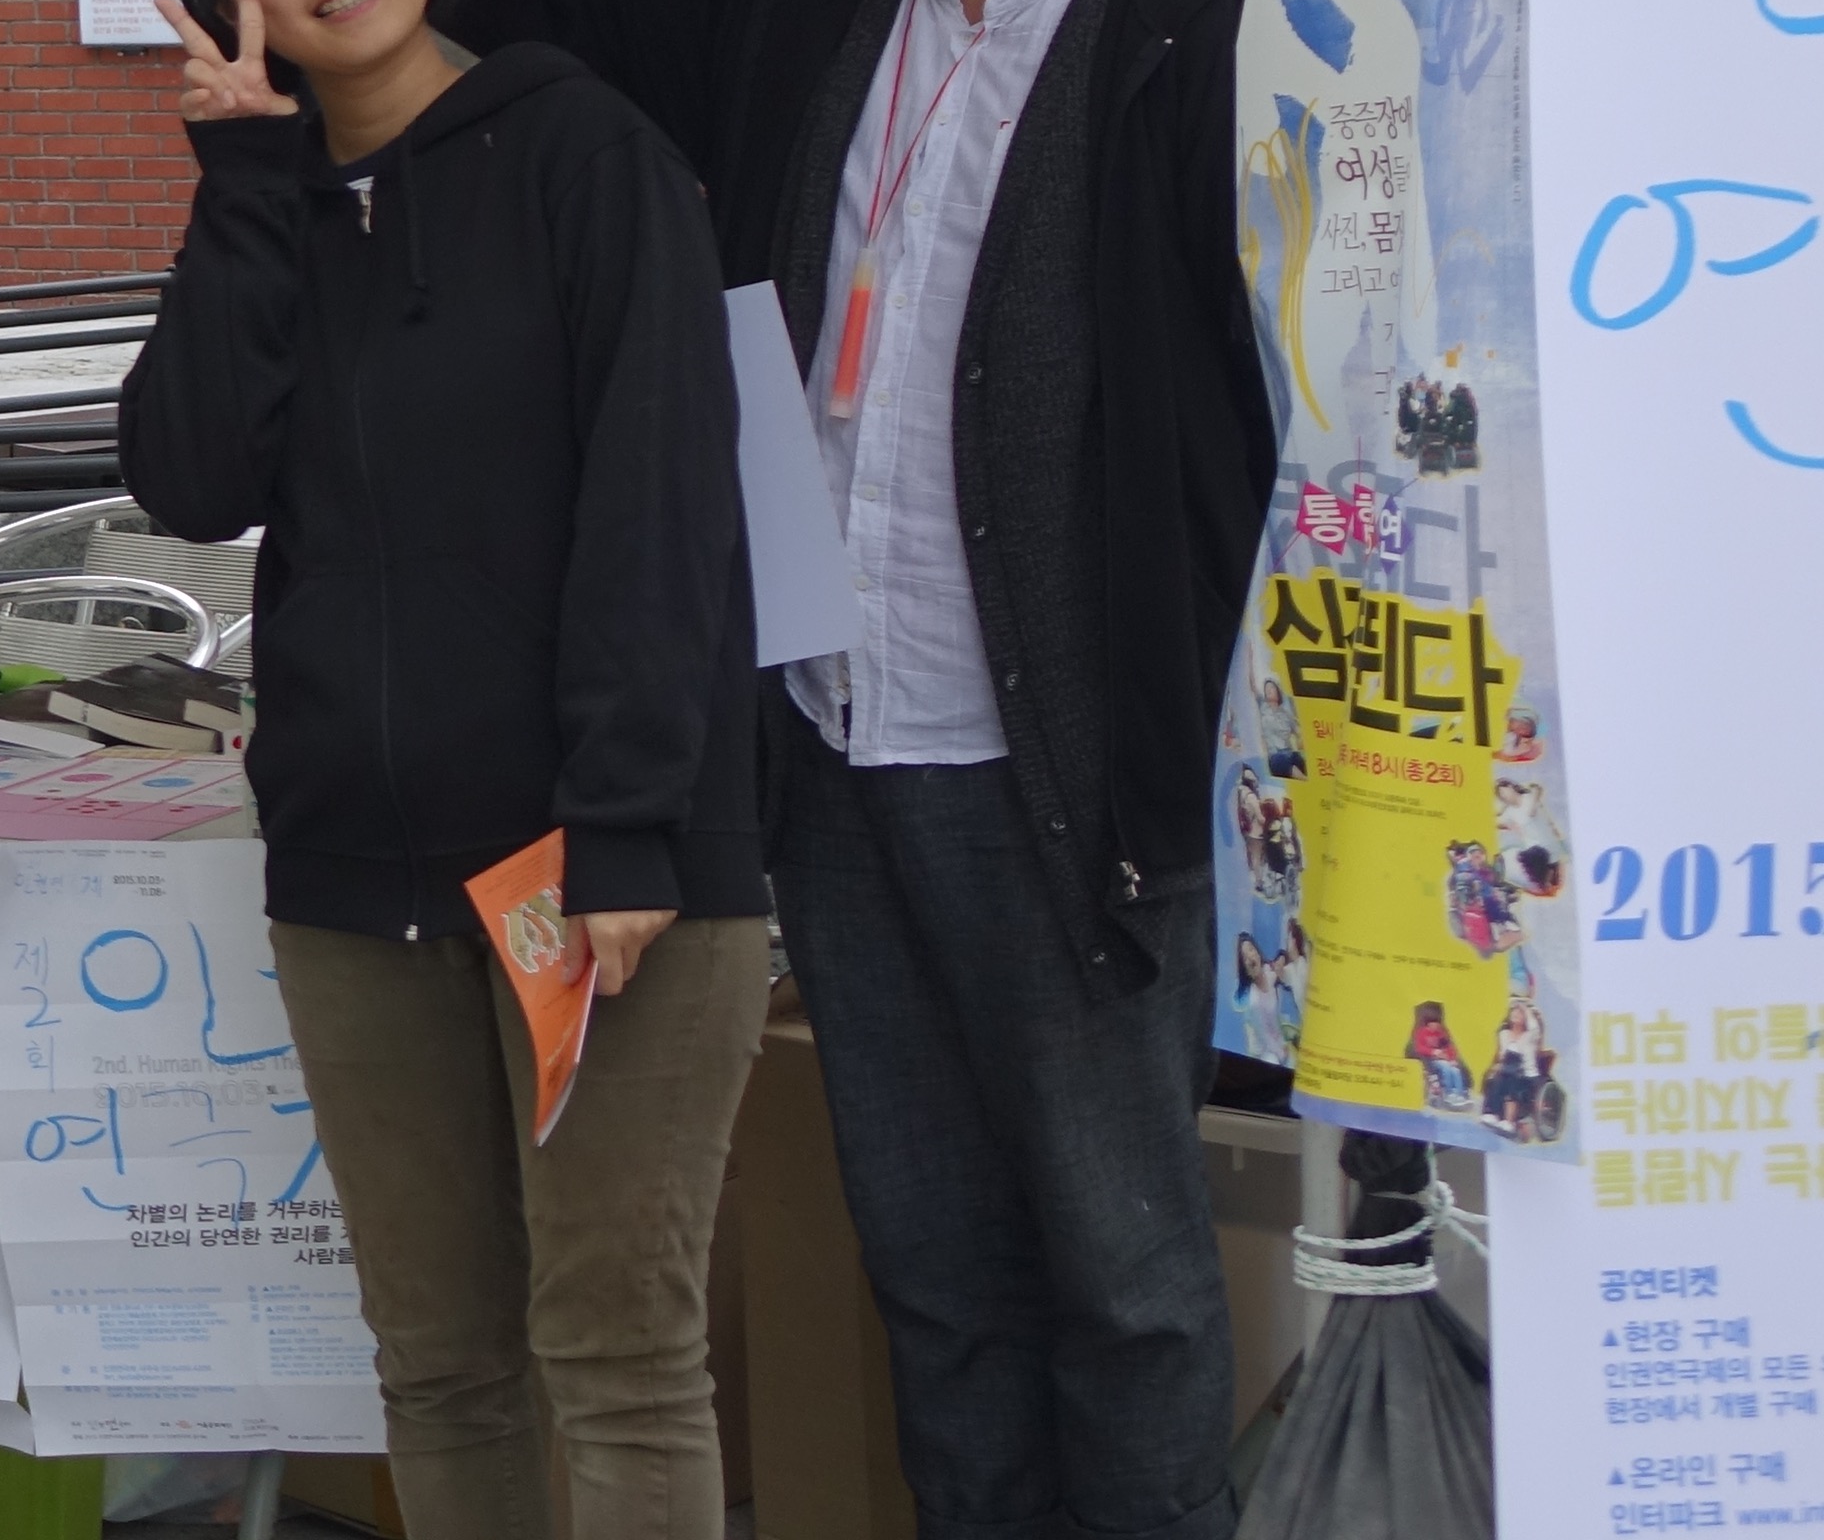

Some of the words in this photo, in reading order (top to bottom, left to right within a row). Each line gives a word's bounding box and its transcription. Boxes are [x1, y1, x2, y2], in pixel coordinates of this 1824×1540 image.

[1321, 265, 1386, 294] 그리고
[80, 921, 296, 1065] 인
[93, 1056, 134, 1074] 2nd.
[138, 1055, 201, 1075] Human
[126, 1204, 188, 1224] 차별의
[196, 1202, 257, 1224] 논리를
[267, 1198, 344, 1220] 거부하는
[131, 1226, 192, 1249] 인간의
[199, 1225, 262, 1247] 당연한
[270, 1222, 332, 1245] 권리를
[294, 1245, 356, 1266] 사람들
[1600, 1264, 1718, 1302] 공연티켓
[1624, 1320, 1681, 1352] 현장
[1692, 1316, 1750, 1349] 구매
[1605, 1357, 1751, 1389] 인권연극제의
[1762, 1354, 1810, 1380] 모든
[1605, 1393, 1701, 1424] 현장에서
[1711, 1391, 1758, 1418] 개별
[1769, 1388, 1818, 1417] 구매
[1629, 1455, 1716, 1489] 온라인
[1727, 1451, 1785, 1485] 구매
[1611, 1499, 1726, 1536] 인터파크
